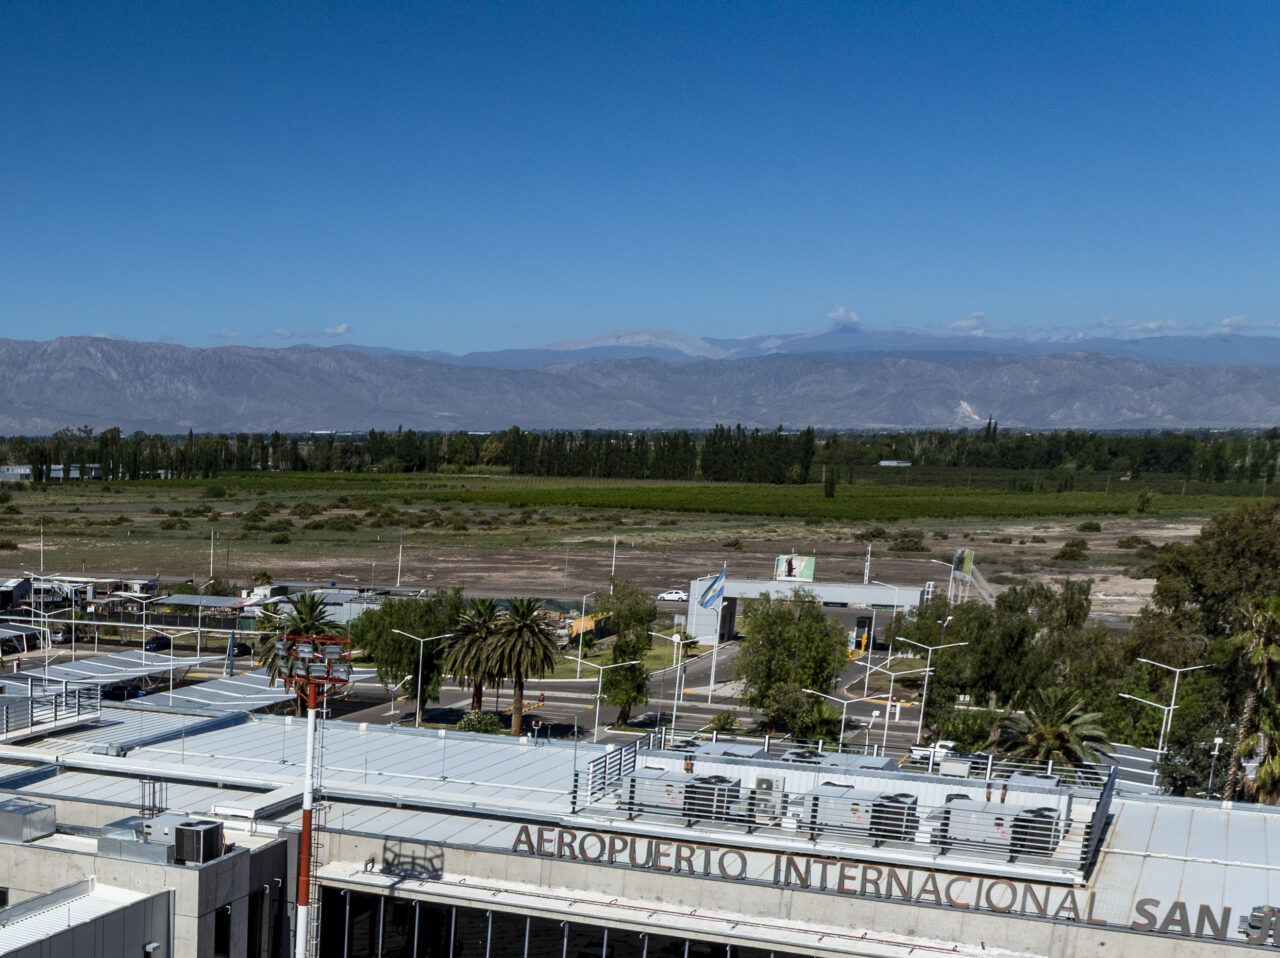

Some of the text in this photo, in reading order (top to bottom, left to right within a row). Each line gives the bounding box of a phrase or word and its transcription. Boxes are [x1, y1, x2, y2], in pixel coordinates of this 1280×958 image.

[513, 825, 1280, 947] AEROPUERTO INTERNACIONAL SAN J
